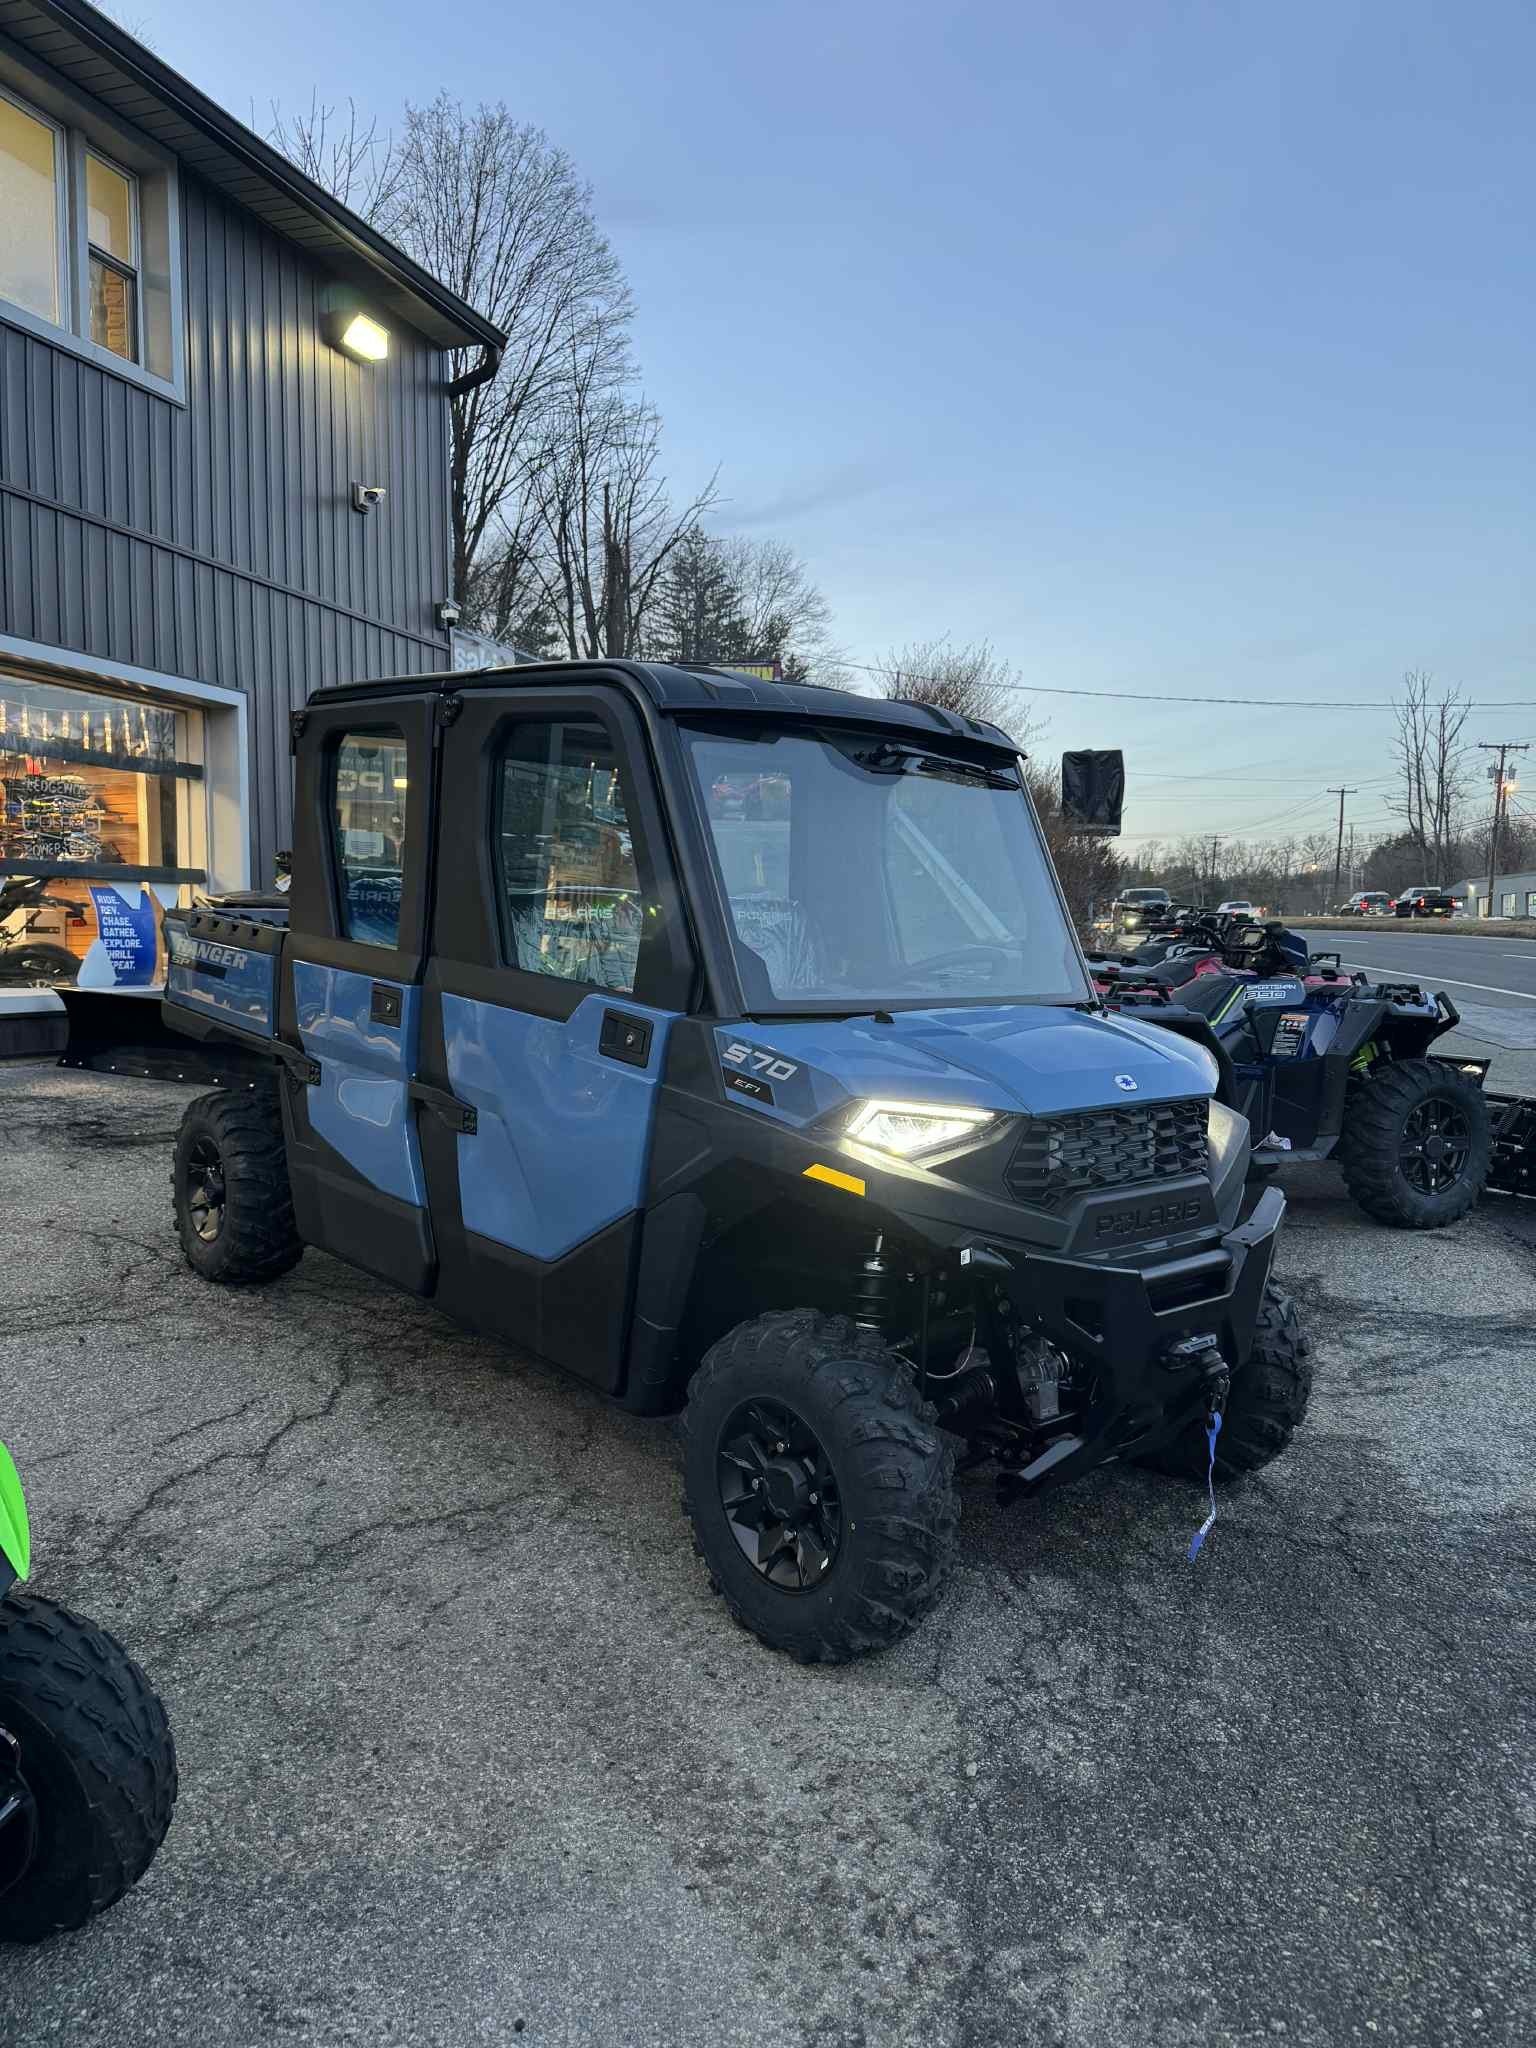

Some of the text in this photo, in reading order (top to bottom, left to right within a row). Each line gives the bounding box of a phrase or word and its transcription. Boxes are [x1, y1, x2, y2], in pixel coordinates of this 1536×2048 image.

[97, 895, 120, 904] RIDE.
[101, 906, 120, 915] REV.
[102, 917, 132, 926] CHASE.
[103, 928, 137, 937] GATHER.
[104, 939, 143, 948] EXPLORE.
[111, 961, 136, 969] PEAT.
[1243, 991, 1286, 1000] 850
[722, 1043, 798, 1081] 570
[734, 1079, 761, 1093] EFI
[1096, 1199, 1201, 1240] POLARIS
